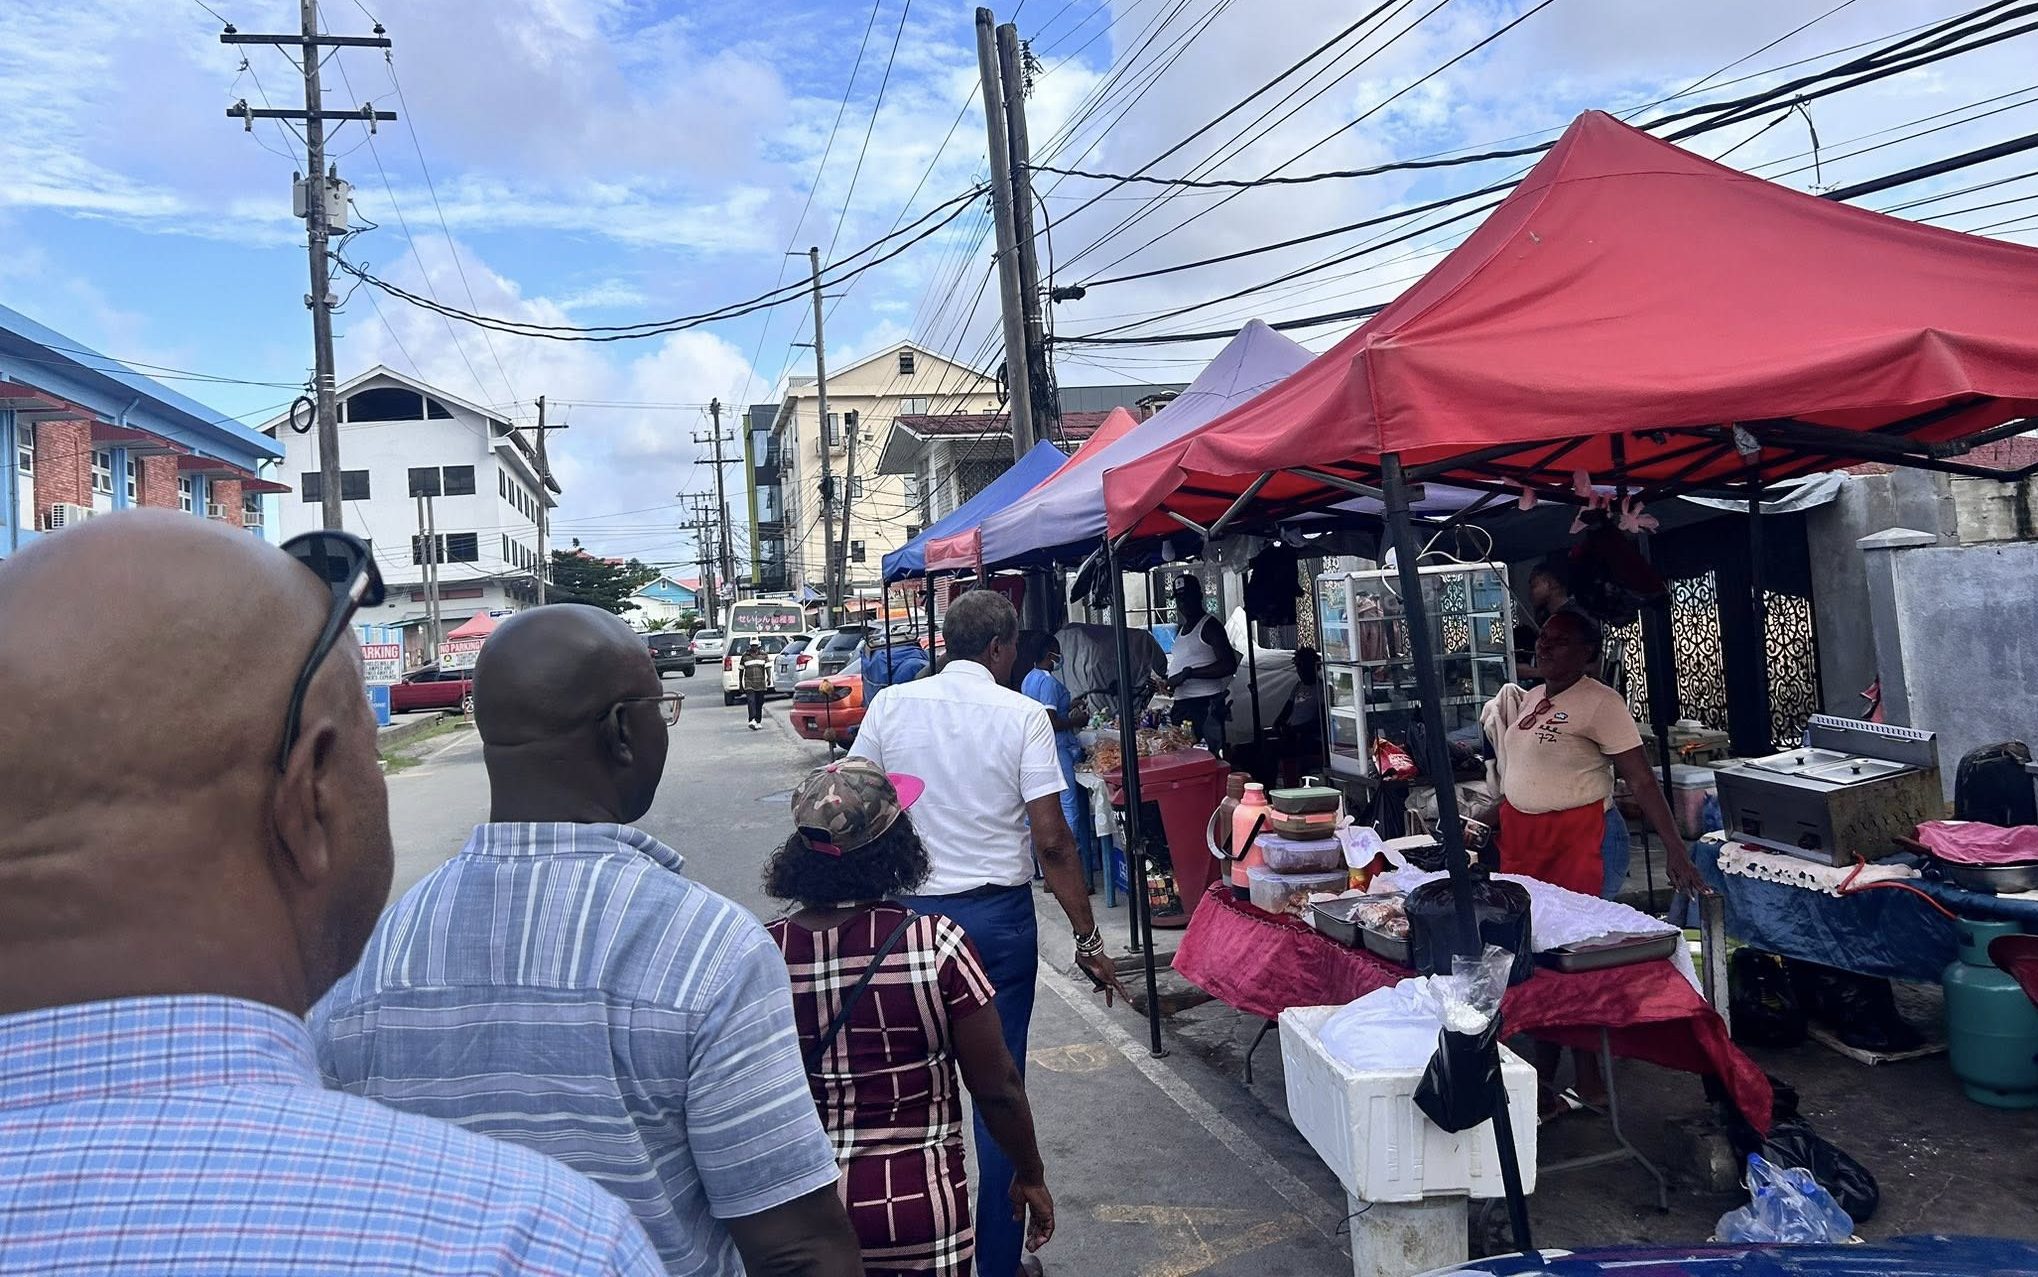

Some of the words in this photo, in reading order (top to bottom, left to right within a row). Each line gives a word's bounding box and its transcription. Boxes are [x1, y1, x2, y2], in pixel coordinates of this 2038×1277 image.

[361, 646, 399, 659] ARKING
[440, 644, 450, 653] NO
[451, 641, 480, 652] PARKING
